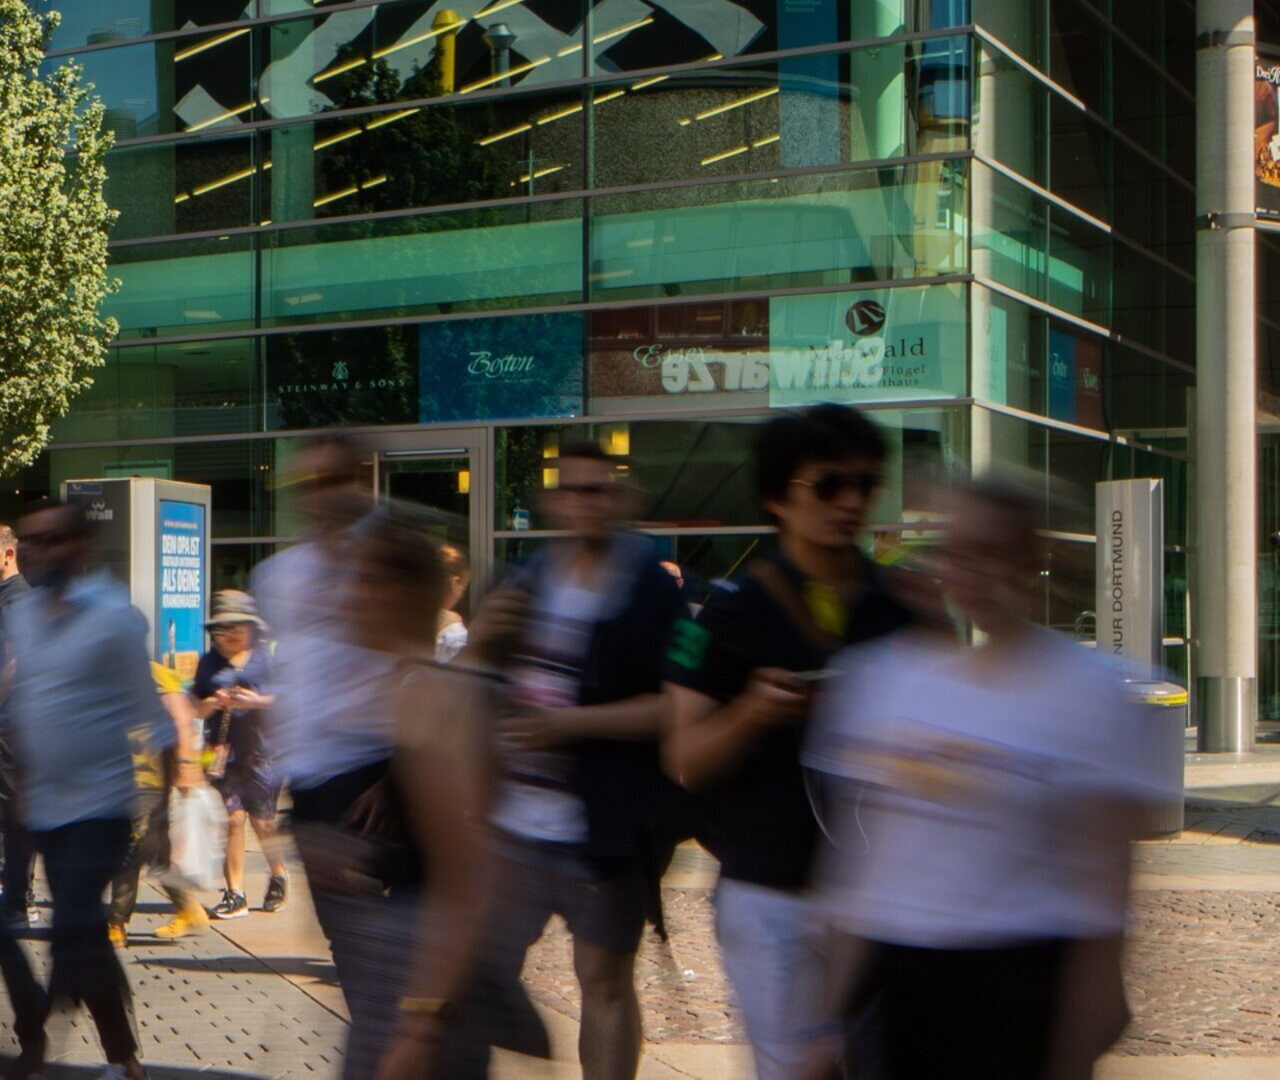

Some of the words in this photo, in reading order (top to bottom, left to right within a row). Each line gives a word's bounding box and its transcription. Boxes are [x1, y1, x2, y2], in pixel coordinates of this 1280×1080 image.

[467, 351, 535, 378] Boston
[278, 381, 349, 394] STEINWAY
[370, 378, 406, 389] SONS
[162, 534, 177, 554] DEIN
[177, 535, 190, 555] OPA
[1112, 510, 1123, 612] DORTMUND
[162, 568, 177, 592] ALS
[1112, 616, 1123, 654] NUR
